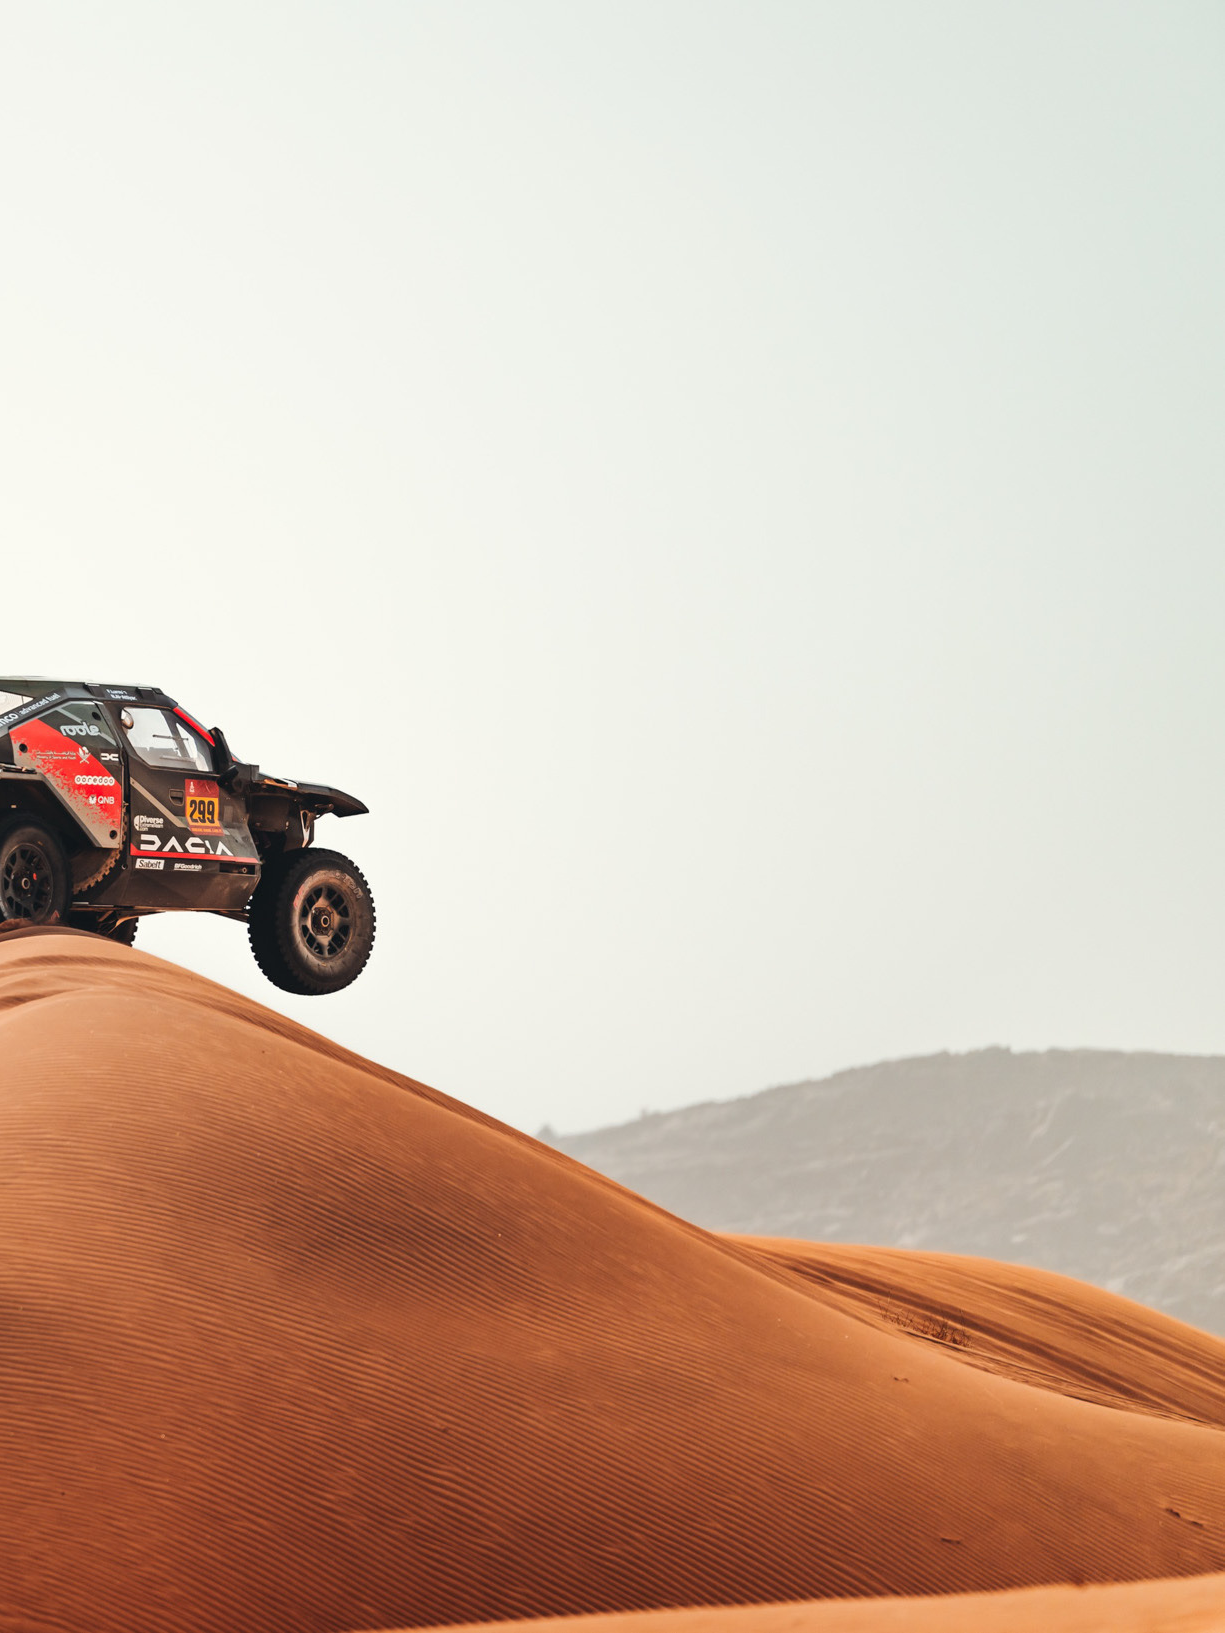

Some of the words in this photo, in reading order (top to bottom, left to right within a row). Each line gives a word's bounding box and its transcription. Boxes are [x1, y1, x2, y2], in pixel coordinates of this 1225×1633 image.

[19, 698, 50, 715] advanced
[45, 692, 61, 701] fuel
[60, 721, 101, 736] roole
[74, 775, 115, 786] ooredoo
[97, 795, 115, 804] QNB
[189, 799, 215, 824] 299
[140, 815, 164, 824] Diverse
[140, 834, 234, 857] DACIA
[138, 859, 161, 869] Sabelt
